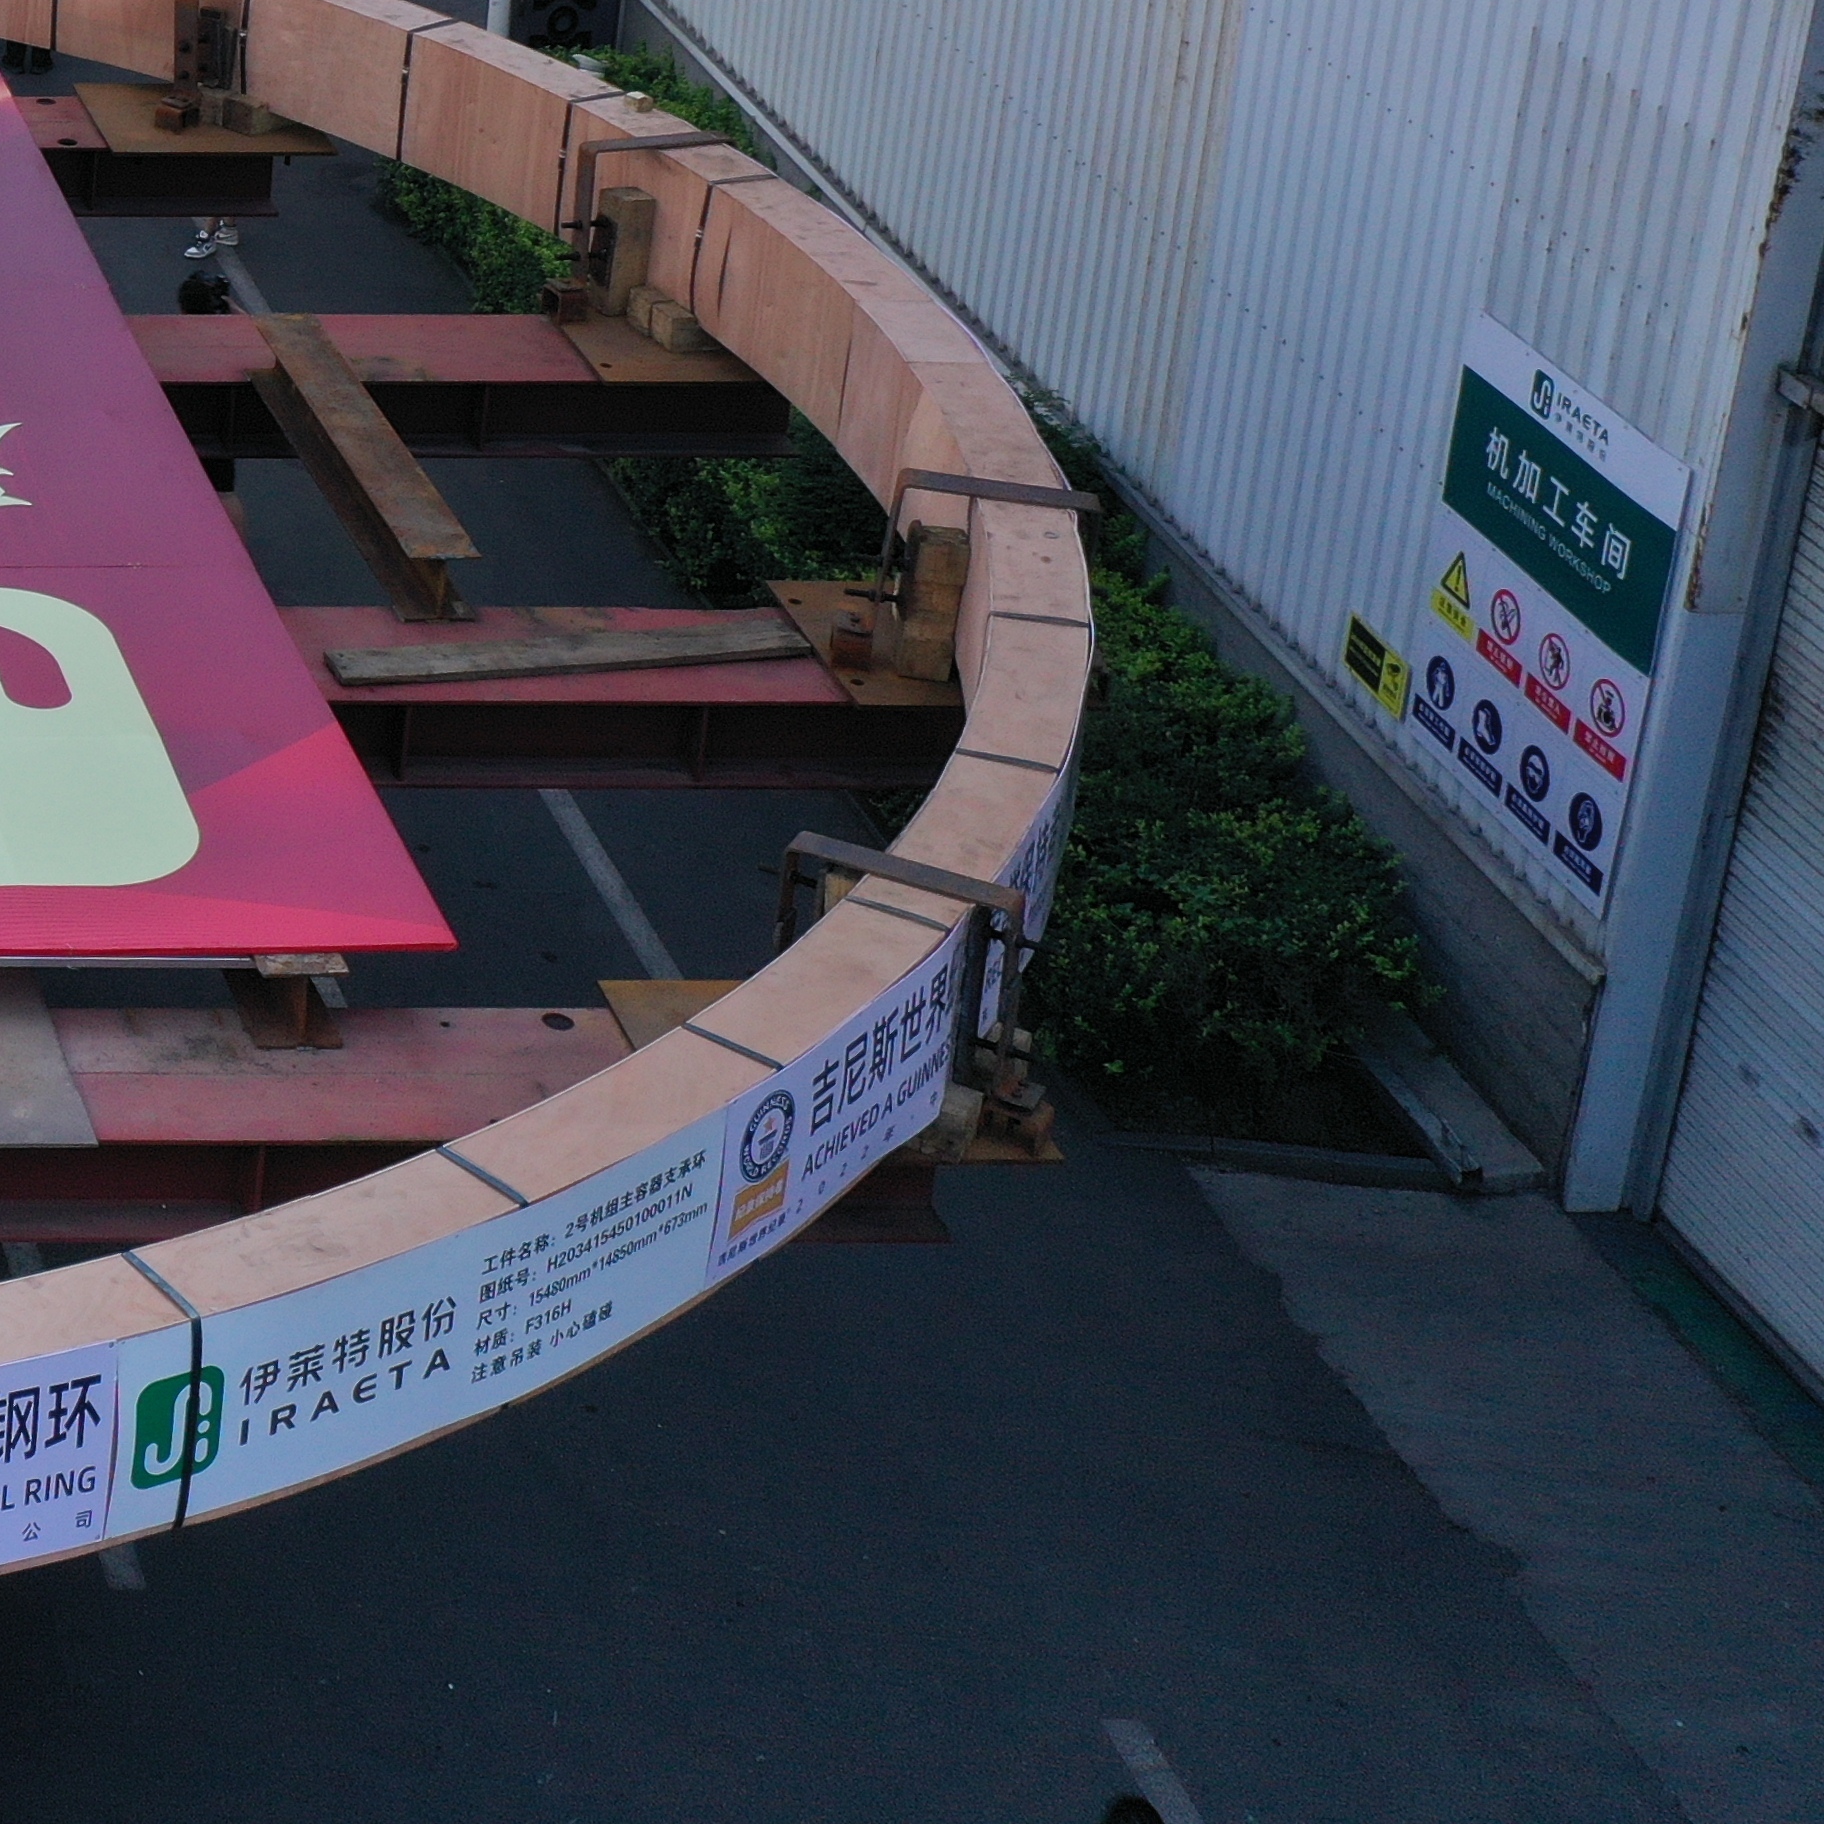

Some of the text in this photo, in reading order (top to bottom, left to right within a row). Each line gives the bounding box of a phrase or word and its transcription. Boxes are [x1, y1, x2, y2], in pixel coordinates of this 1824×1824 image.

[1556, 392, 1610, 447] IRAETA
[1486, 426, 1632, 580] 机加工车间
[1487, 481, 1612, 594] MACHINING WORKSHOP
[801, 1033, 952, 1182] ACHIEVED A GUINNES
[238, 1297, 458, 1407] 伊莱特股份
[239, 1348, 452, 1447] IRAETA
[471, 1338, 542, 1384] 注意吊装
[23, 1465, 97, 1511] RING
